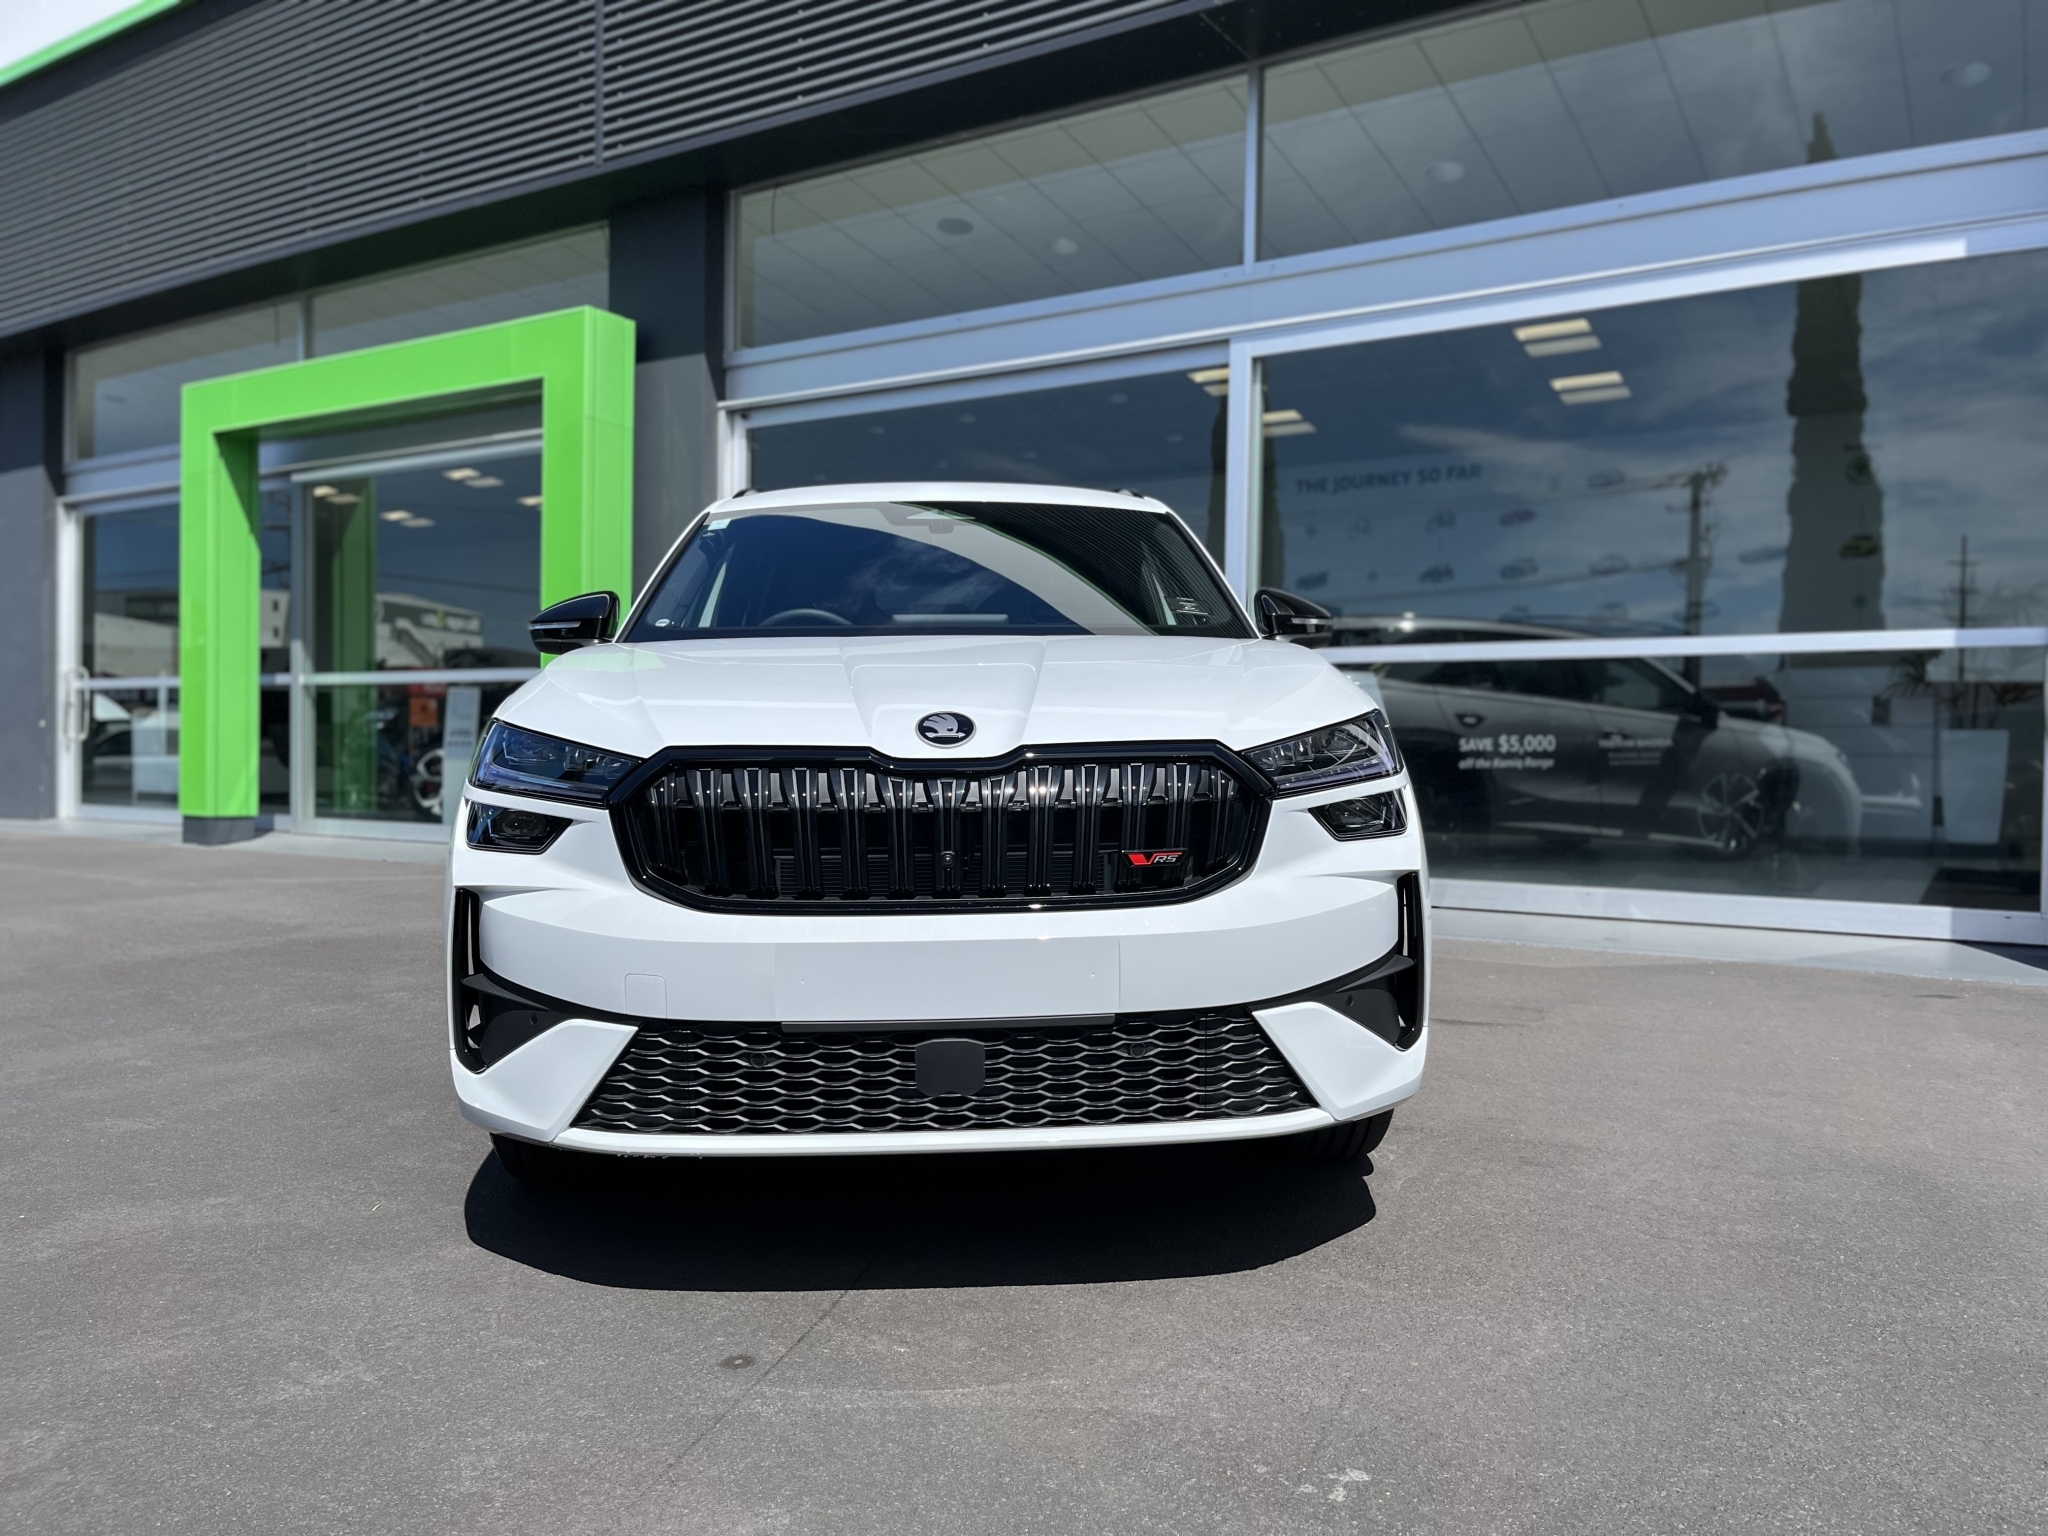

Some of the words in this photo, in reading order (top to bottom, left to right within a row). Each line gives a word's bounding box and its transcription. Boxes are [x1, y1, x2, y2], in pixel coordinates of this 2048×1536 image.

[1296, 478, 1328, 494] THE
[1331, 470, 1411, 495] JOURNEY
[1417, 467, 1442, 485] SO
[1445, 463, 1482, 482] FAR
[1458, 737, 1494, 752] SAVE
[1498, 733, 1557, 755] $5,000
[1458, 757, 1474, 770] off
[1475, 757, 1491, 769] the
[1524, 756, 1555, 770] Range
